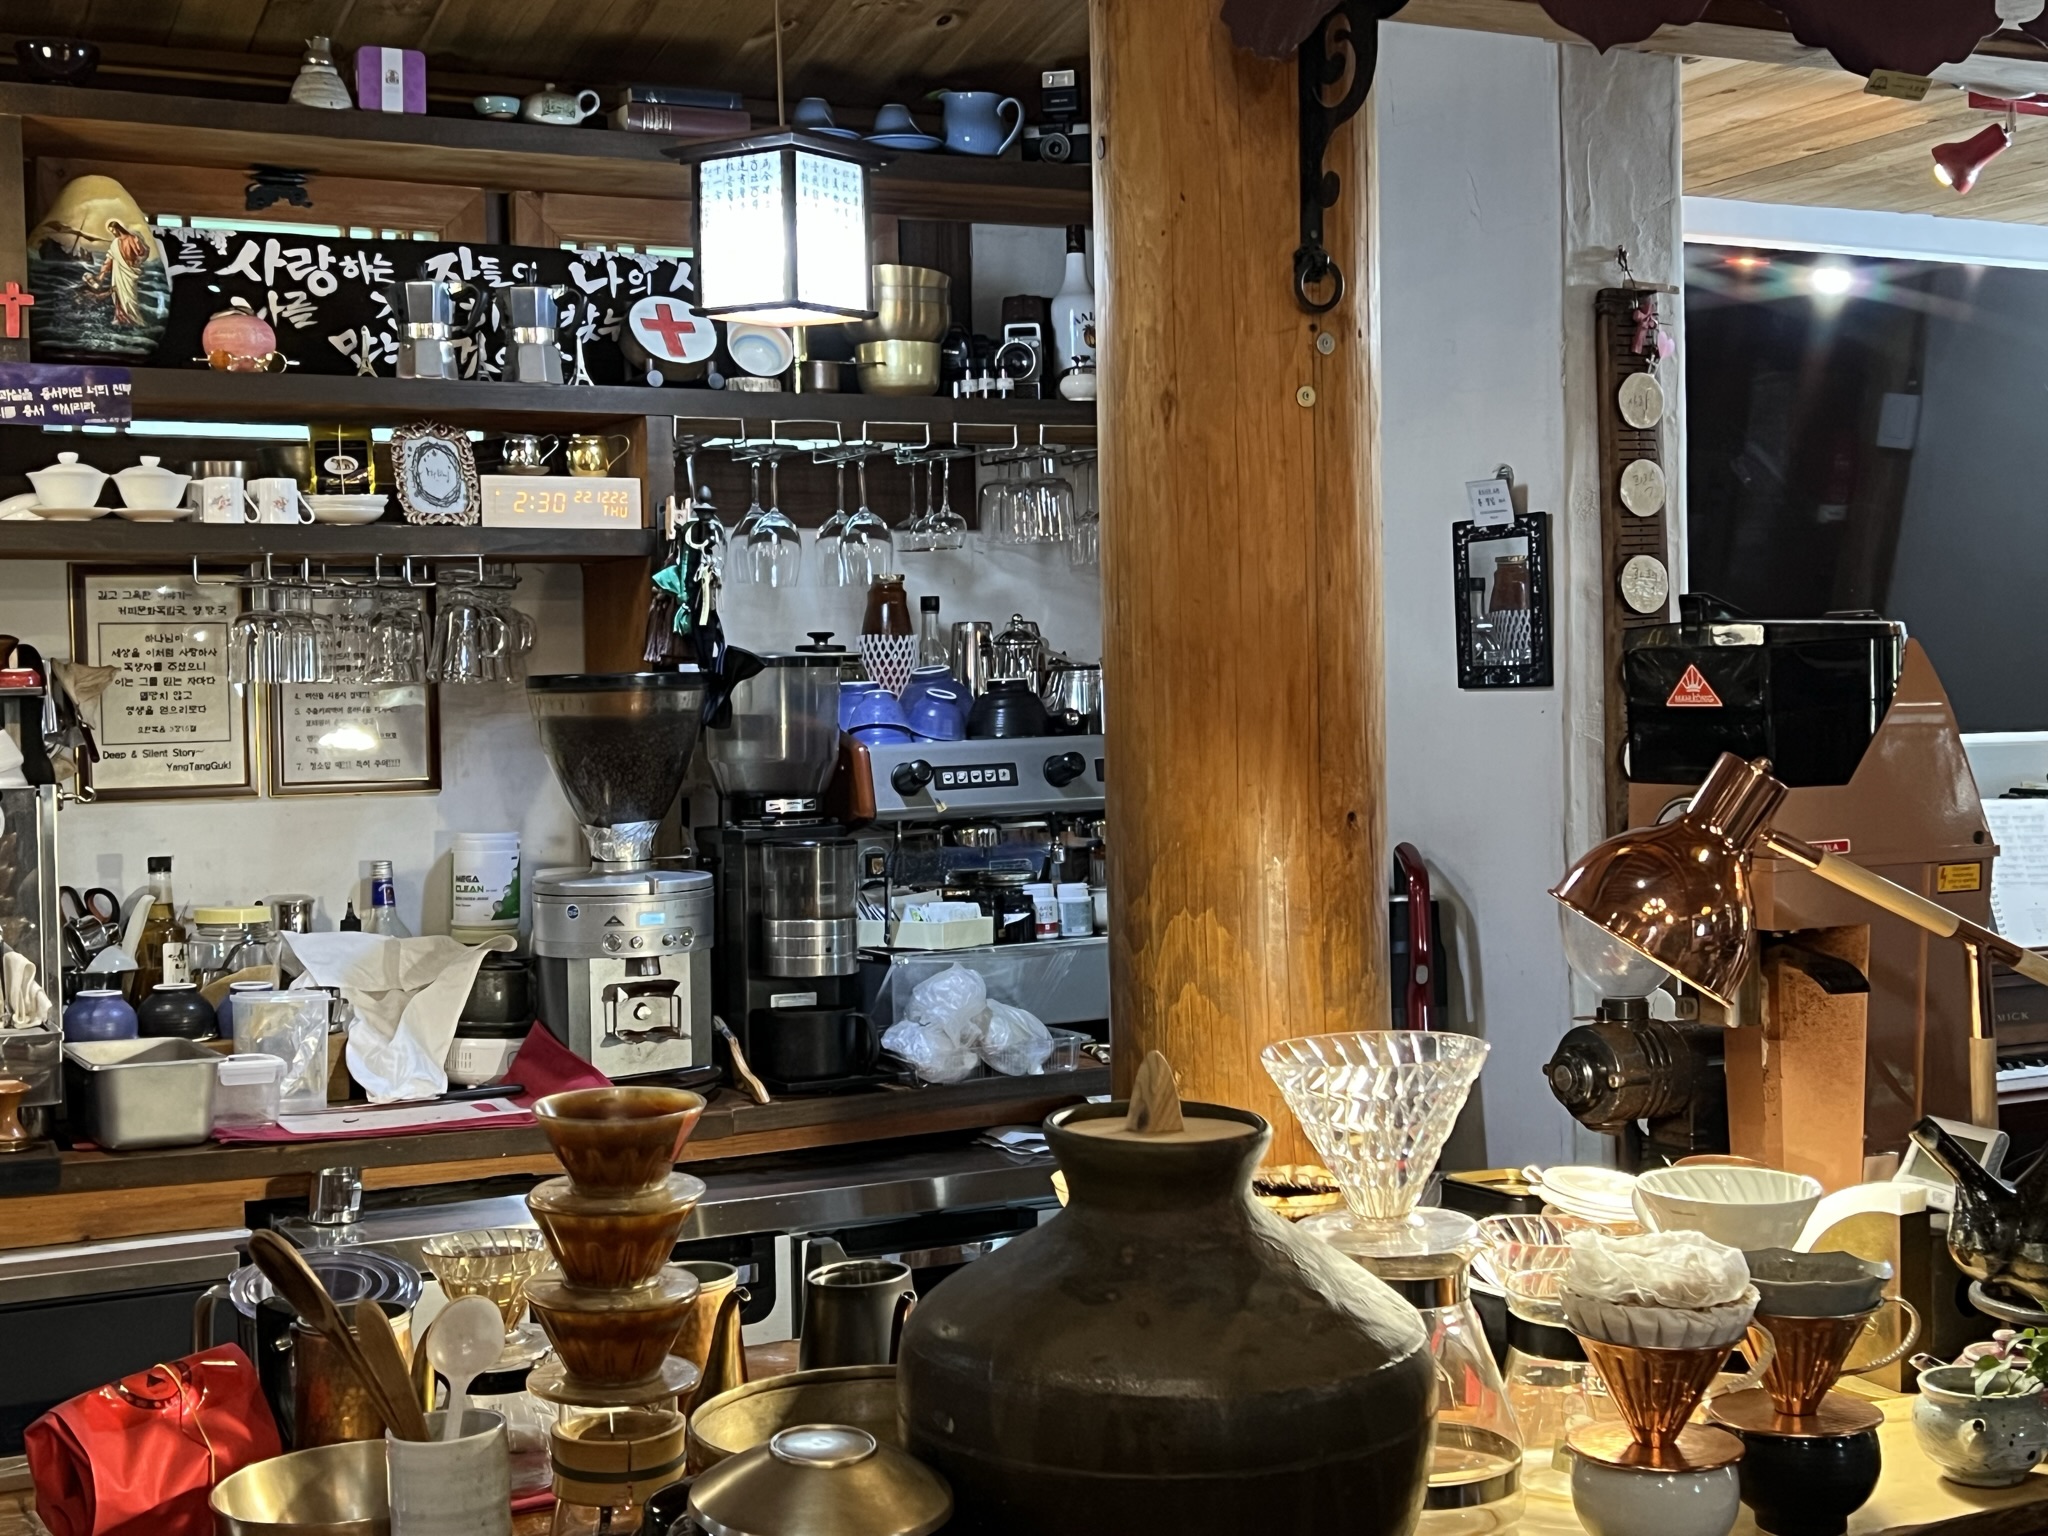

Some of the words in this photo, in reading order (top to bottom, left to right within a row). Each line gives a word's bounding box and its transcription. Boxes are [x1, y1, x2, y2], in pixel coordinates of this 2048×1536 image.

[214, 238, 395, 297] 사랑하는
[568, 260, 652, 298] 나의
[86, 384, 109, 397] 너희
[22, 404, 45, 418] 용서
[513, 491, 567, 514] 2:30
[603, 504, 629, 518] THU
[145, 633, 184, 643] 하나님이
[111, 648, 140, 659] 세상을
[146, 648, 175, 658] 이처럼
[179, 648, 218, 658] 사랑하사
[123, 662, 163, 672] 독생자를
[167, 662, 206, 672] 주셨으니
[138, 677, 158, 687] 그를
[163, 677, 183, 687] 믿는
[187, 676, 216, 686] 자마다
[139, 691, 169, 702] 멸망치
[173, 691, 193, 700] 않고
[125, 706, 154, 716] 영생을
[102, 751, 127, 760] Deep
[131, 750, 138, 759] &
[142, 750, 169, 759] Silent
[455, 875, 480, 883] MEGA
[455, 885, 484, 893] CLEAN
